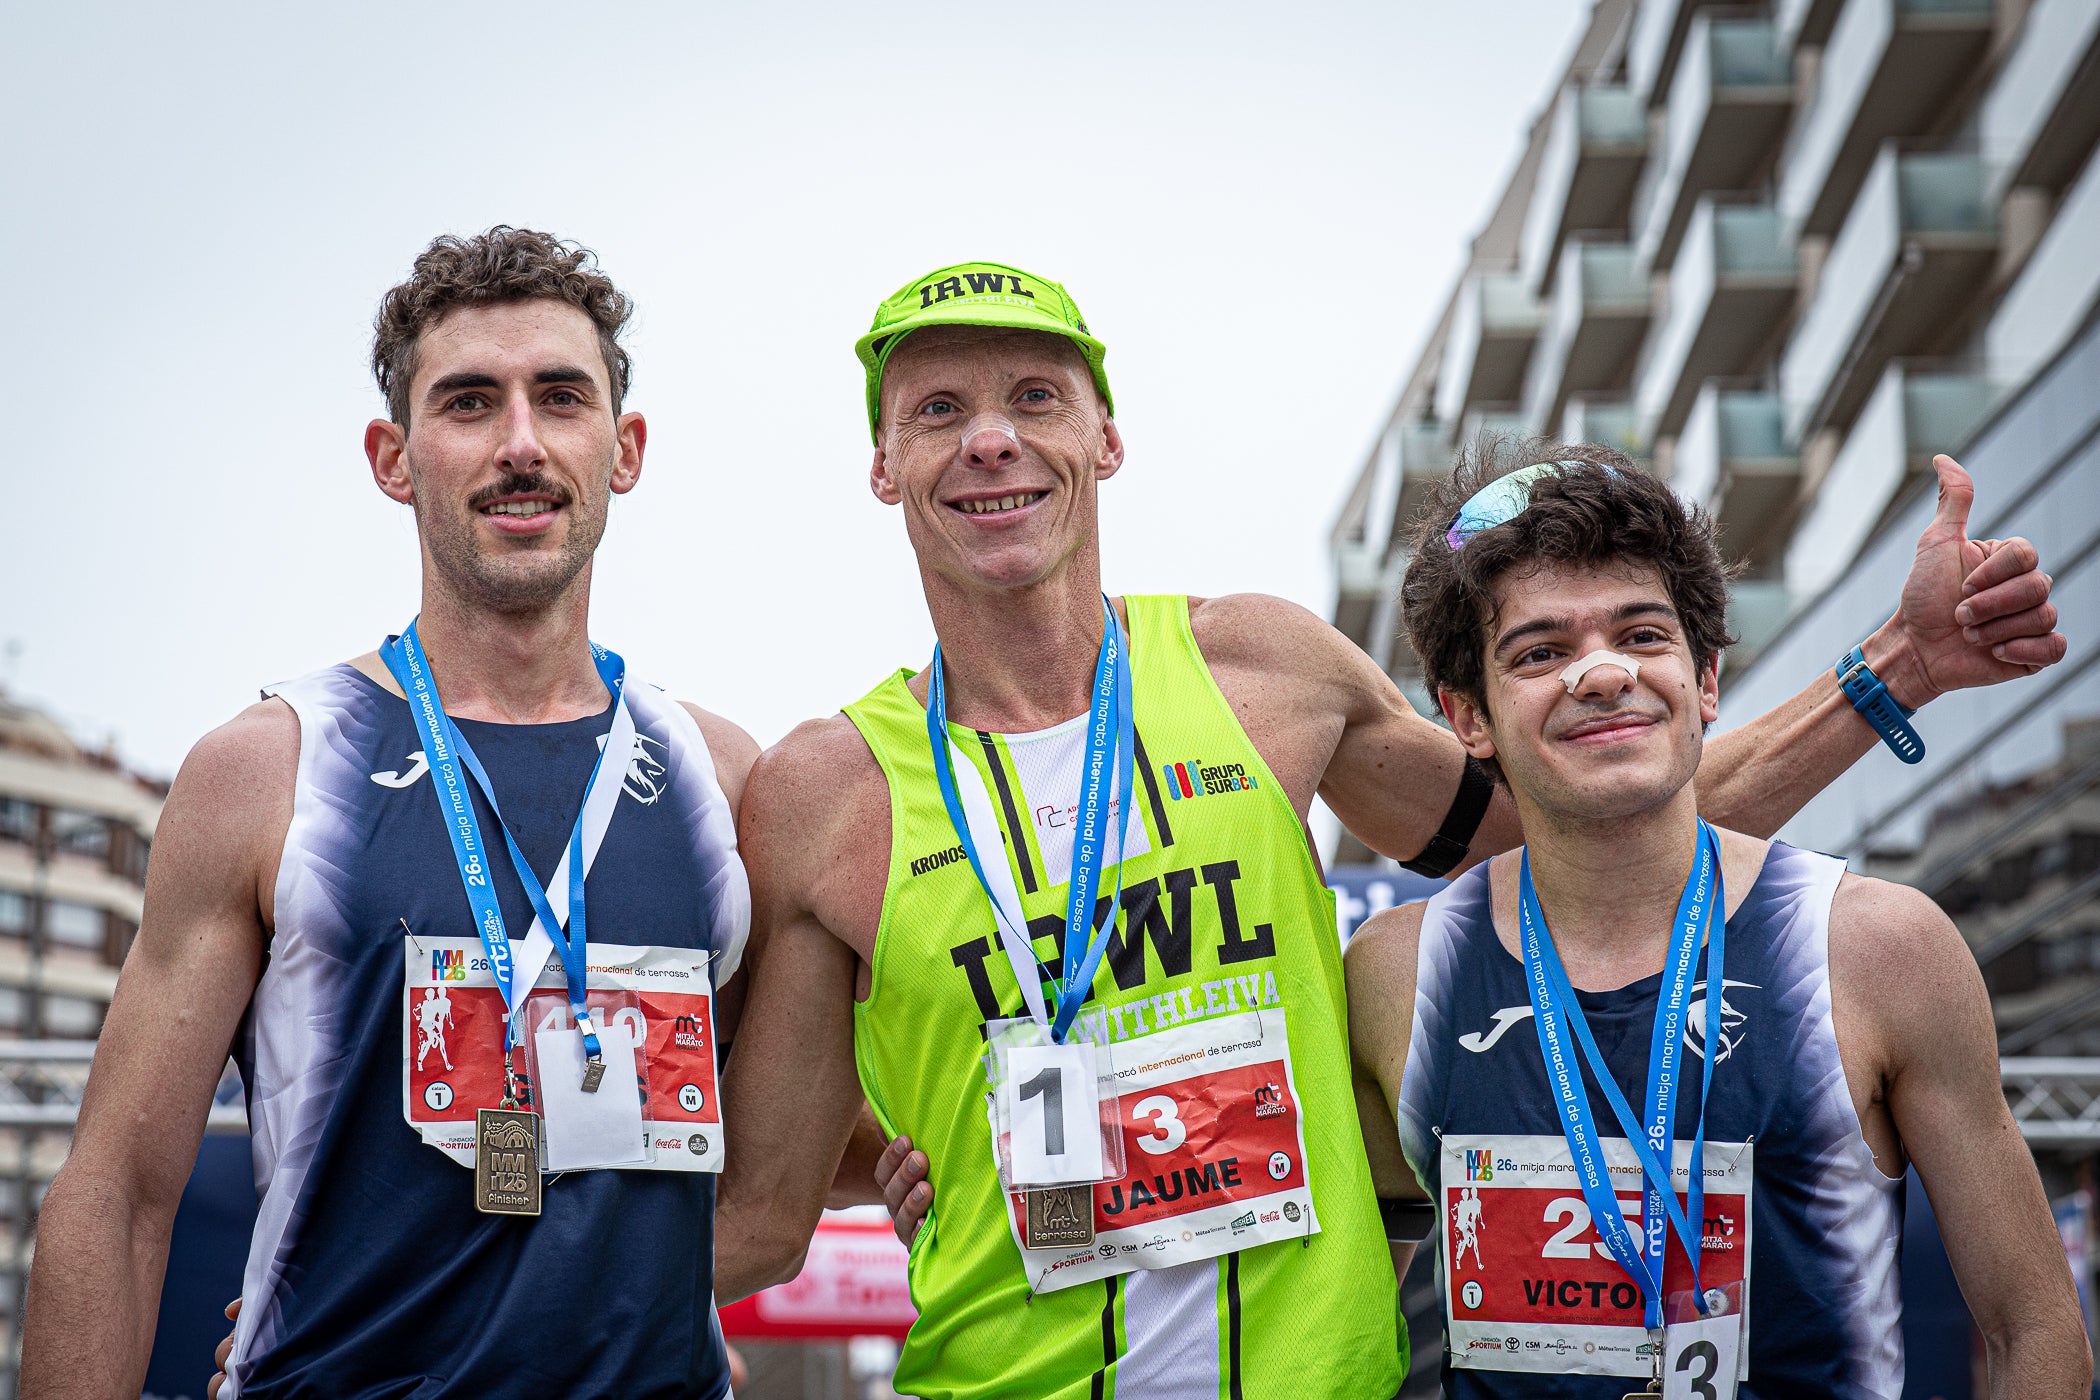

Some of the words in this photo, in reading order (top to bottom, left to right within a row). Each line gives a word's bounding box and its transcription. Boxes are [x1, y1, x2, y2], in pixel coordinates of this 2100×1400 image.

[920, 273, 1034, 309] IRWL
[403, 634, 421, 678] terrassa
[413, 677, 427, 691] de
[1099, 665, 1115, 697] mitja
[416, 692, 450, 761] internacional
[1094, 696, 1109, 747] marató
[439, 763, 464, 814] marató
[1200, 763, 1245, 782] GRUPO
[1205, 776, 1258, 796] SURBCN
[1083, 750, 1104, 842] internacional
[457, 817, 476, 850] mitja
[1081, 843, 1094, 863] de
[465, 855, 486, 887] 26a
[1693, 849, 1711, 902] terrassa
[1073, 866, 1090, 933] terrassa
[1690, 902, 1701, 922] de
[484, 920, 495, 943] MITJA
[485, 909, 501, 943] MARATÓ
[470, 959, 492, 970] 26
[586, 965, 633, 976] ernacional
[634, 968, 646, 977] de
[648, 970, 690, 979] terrassa
[1668, 922, 1698, 1010] internacional
[675, 1038, 704, 1047] MARATÓ
[1139, 1049, 1206, 1074] internacional
[1207, 1046, 1220, 1056] de
[1222, 1039, 1262, 1054] terrassa
[1662, 1011, 1678, 1071] marató
[1532, 960, 1550, 1010] marató
[1543, 1011, 1577, 1103] internacional
[1567, 1103, 1579, 1121] de
[1573, 1126, 1600, 1189] terrassa
[435, 1092, 442, 1106] 1
[685, 1095, 696, 1105] M
[1657, 1072, 1673, 1112] mitja
[1019, 1067, 1065, 1156] 1
[1132, 1095, 1187, 1155] 3
[1255, 1105, 1287, 1118] MARATÓ
[1648, 1116, 1666, 1151] 26a
[1275, 1163, 1285, 1174] M
[1496, 1158, 1518, 1171] 26a
[1520, 1162, 1545, 1174] mitja
[1102, 1157, 1243, 1216] JAUME
[1034, 1230, 1087, 1242] terrassa
[1541, 1196, 1644, 1261] 25
[1047, 1254, 1096, 1274] SPORTIUM
[1066, 1250, 1093, 1259] FUNDACIÓN
[1121, 1244, 1138, 1253] CSM
[1469, 1291, 1475, 1305] 1
[1523, 1279, 1646, 1309] VICTO
[1466, 1340, 1502, 1351] SPORTIUM
[1525, 1341, 1541, 1349] CSM
[1675, 1340, 1719, 1400] 3
